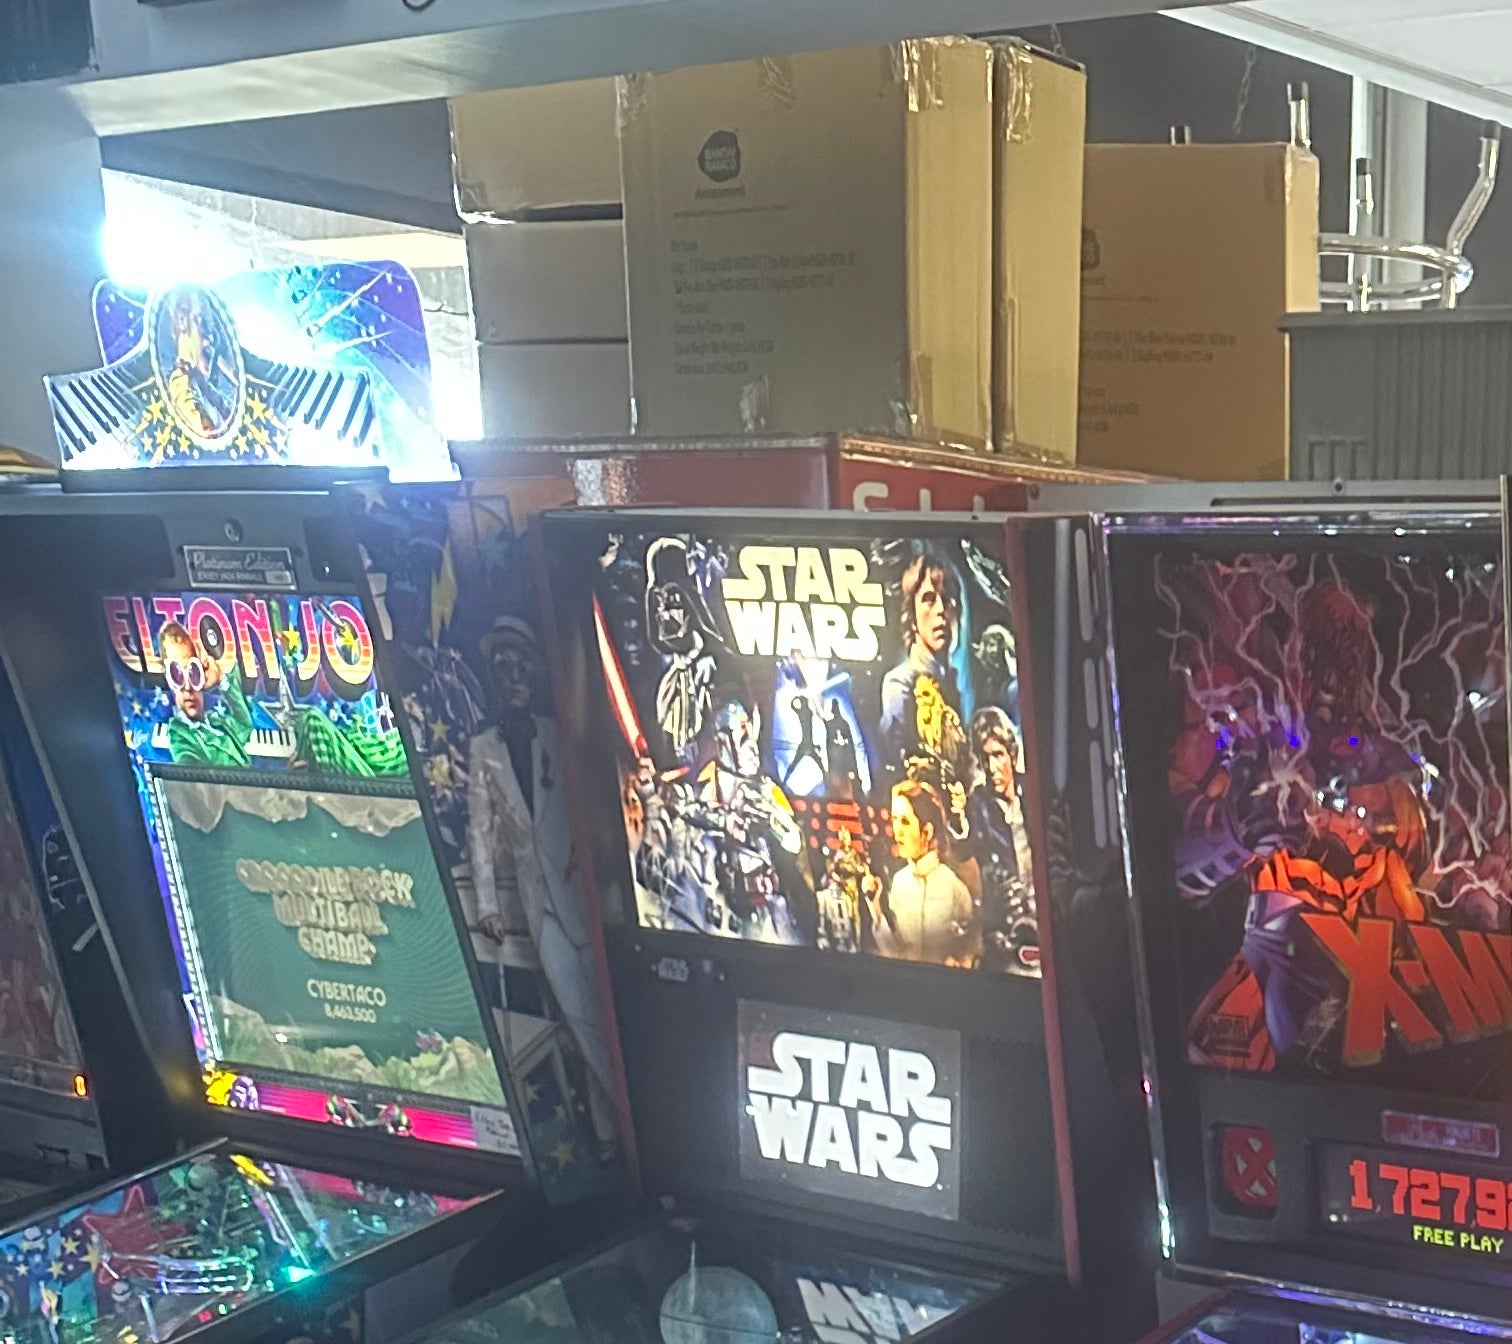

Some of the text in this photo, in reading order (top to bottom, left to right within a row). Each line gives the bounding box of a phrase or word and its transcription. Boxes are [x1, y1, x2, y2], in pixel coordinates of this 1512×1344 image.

[722, 546, 883, 605] STAR
[104, 595, 375, 687] ELTON JO
[724, 600, 886, 661] WARS
[307, 978, 387, 1007] CYBERTACO
[747, 1031, 951, 1125] STAR
[747, 1094, 952, 1190] WARS
[1413, 1225, 1504, 1254] FREE PLAY
